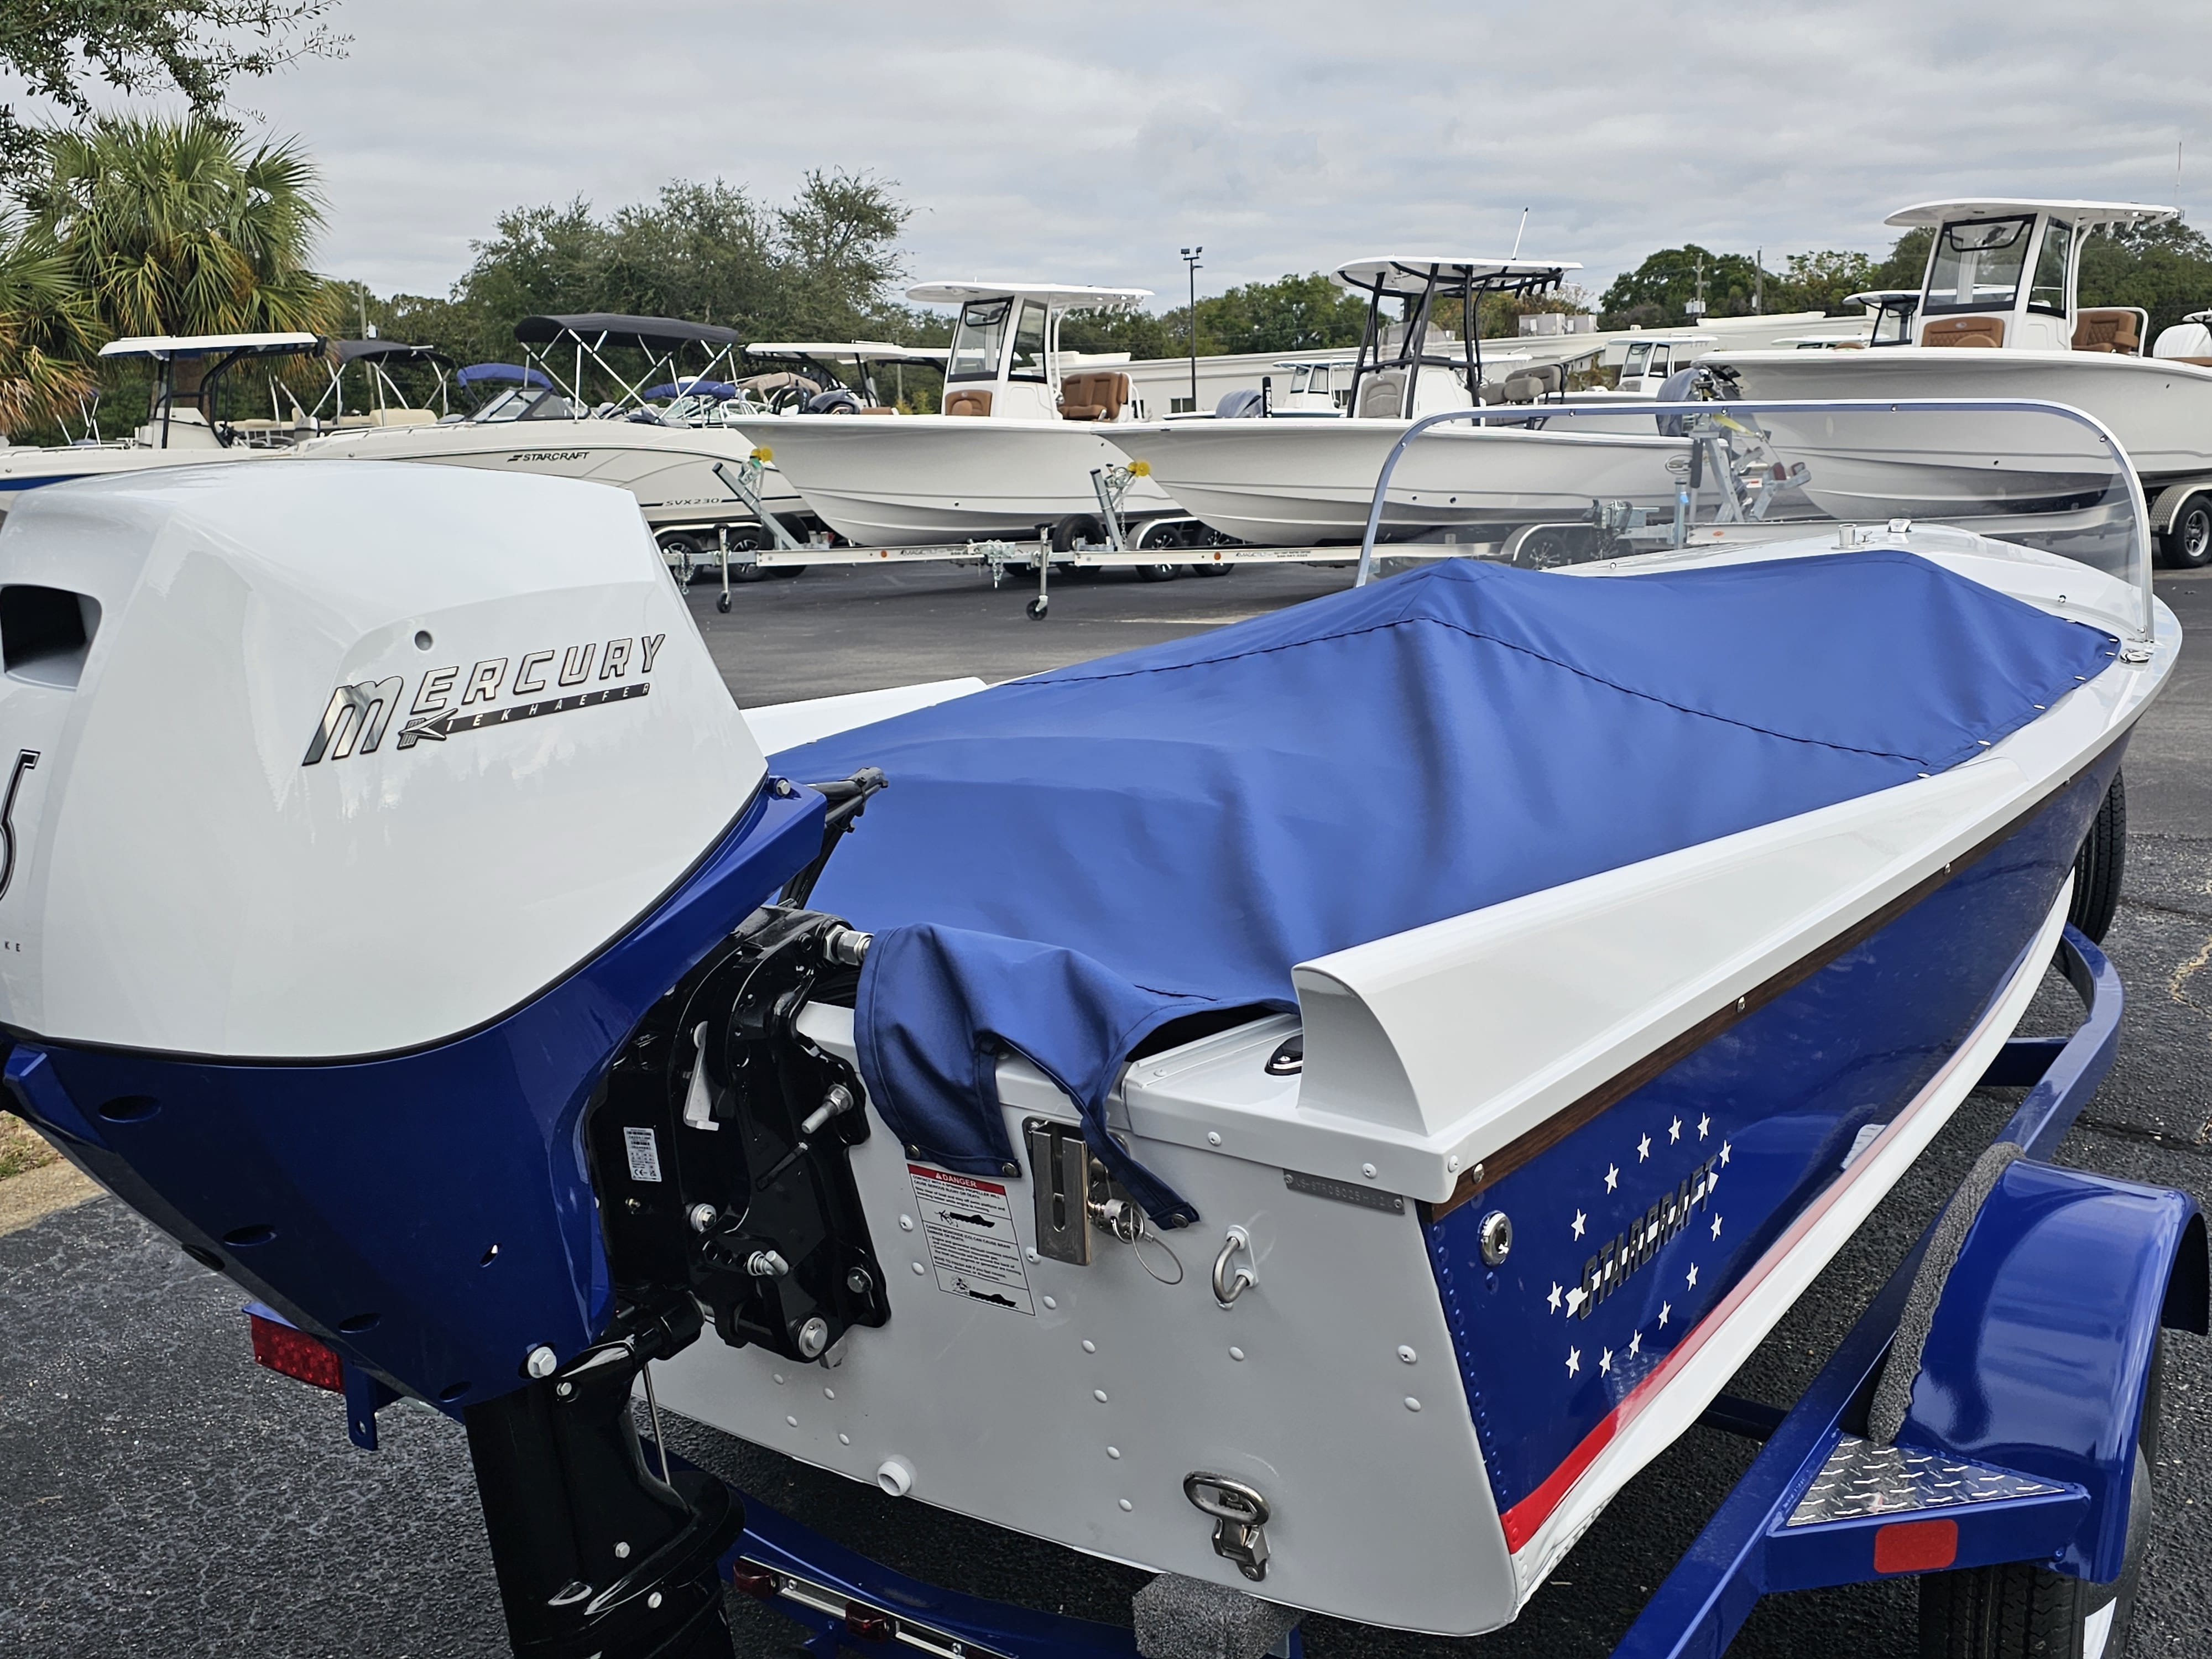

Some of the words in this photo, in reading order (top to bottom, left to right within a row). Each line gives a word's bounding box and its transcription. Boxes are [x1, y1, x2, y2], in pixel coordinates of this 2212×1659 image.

[523, 451, 589, 461] STARCRAFT
[301, 633, 665, 766] MERCURY
[942, 1174, 977, 1188] DANGER
[1579, 1153, 1718, 1321] STARCRAFT
